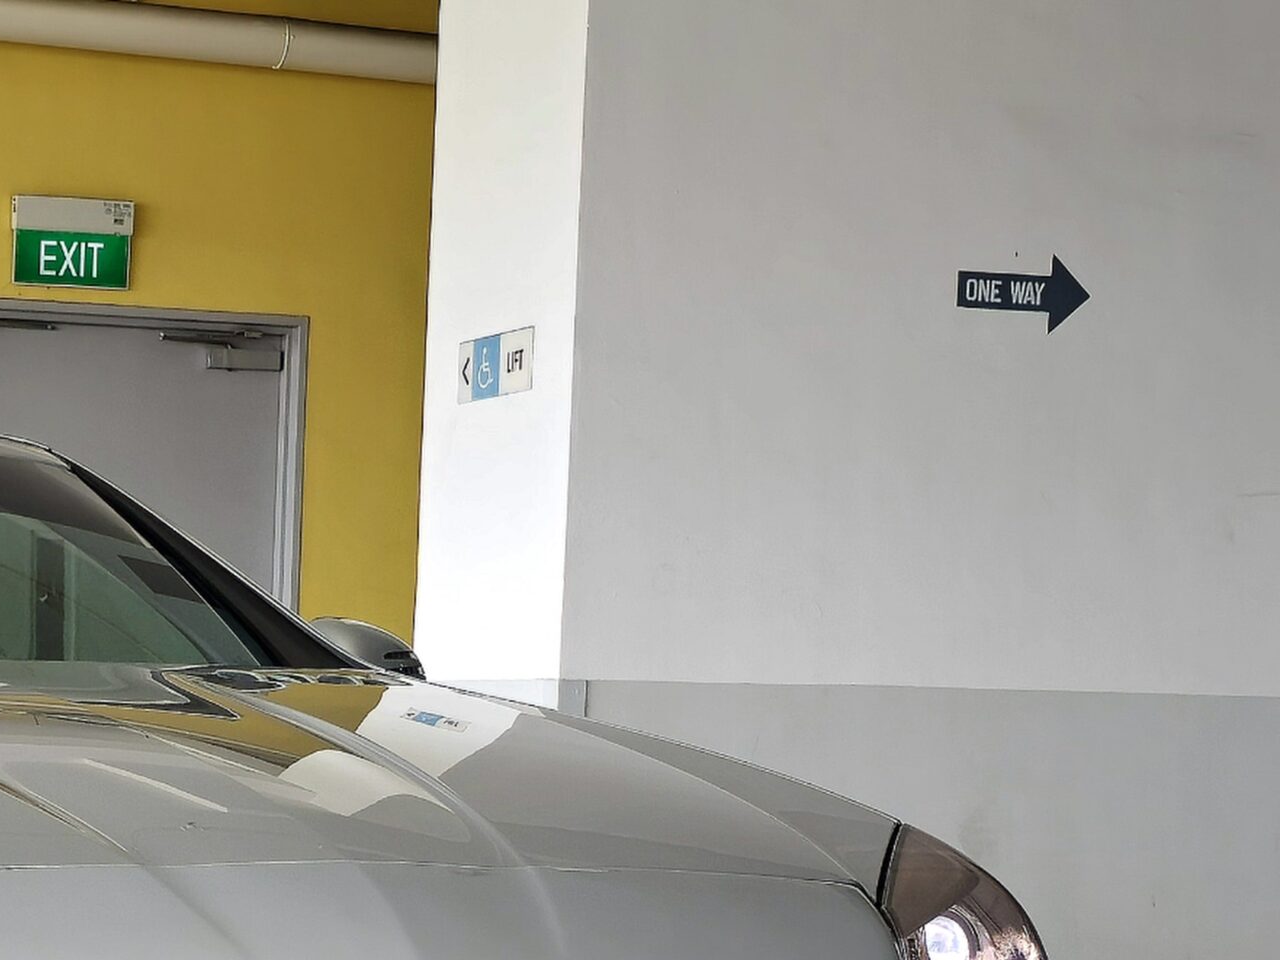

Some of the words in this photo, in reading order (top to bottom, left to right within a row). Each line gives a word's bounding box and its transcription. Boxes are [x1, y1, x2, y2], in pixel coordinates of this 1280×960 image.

[39, 240, 105, 278] EXIT
[965, 278, 1003, 303] ONE
[1010, 281, 1046, 306] WAY
[507, 348, 524, 373] LIFT
